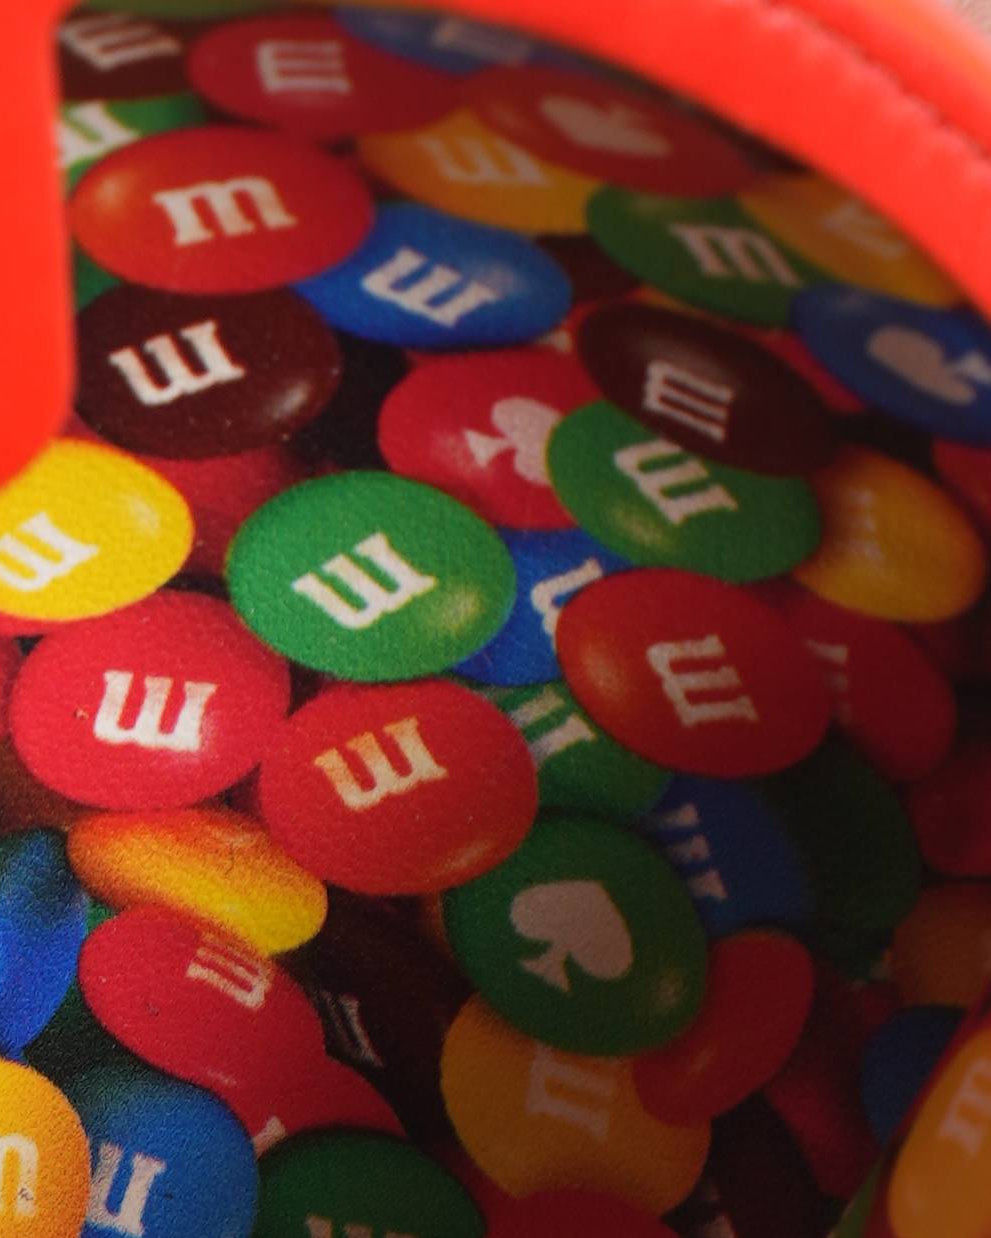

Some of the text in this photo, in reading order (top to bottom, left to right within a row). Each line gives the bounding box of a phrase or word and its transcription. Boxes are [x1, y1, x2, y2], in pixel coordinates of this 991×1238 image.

[256, 40, 349, 93] m
[418, 137, 552, 186] m
[154, 176, 296, 246] m
[362, 249, 498, 327] m
[671, 223, 801, 286] m
[108, 320, 244, 406] m
[644, 361, 733, 442] m
[614, 439, 738, 524] m
[293, 533, 438, 629] m
[93, 671, 217, 752] m
[646, 634, 760, 727] m
[314, 716, 447, 812] m
